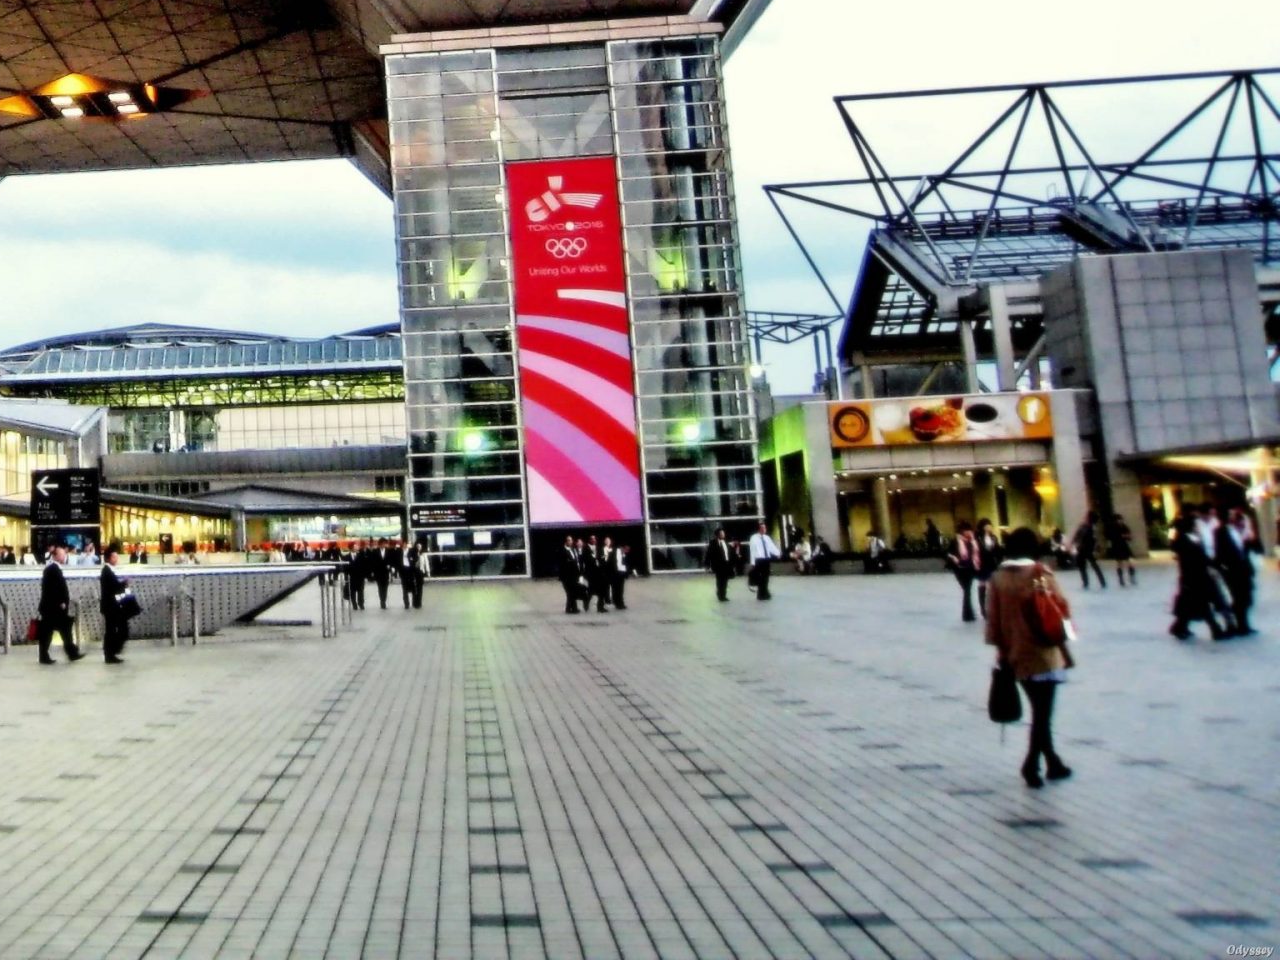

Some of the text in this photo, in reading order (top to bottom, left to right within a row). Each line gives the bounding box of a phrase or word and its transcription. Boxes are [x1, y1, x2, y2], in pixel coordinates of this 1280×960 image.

[527, 220, 604, 232] TOKYO 2016
[528, 264, 607, 277] Uniting Our Worlds
